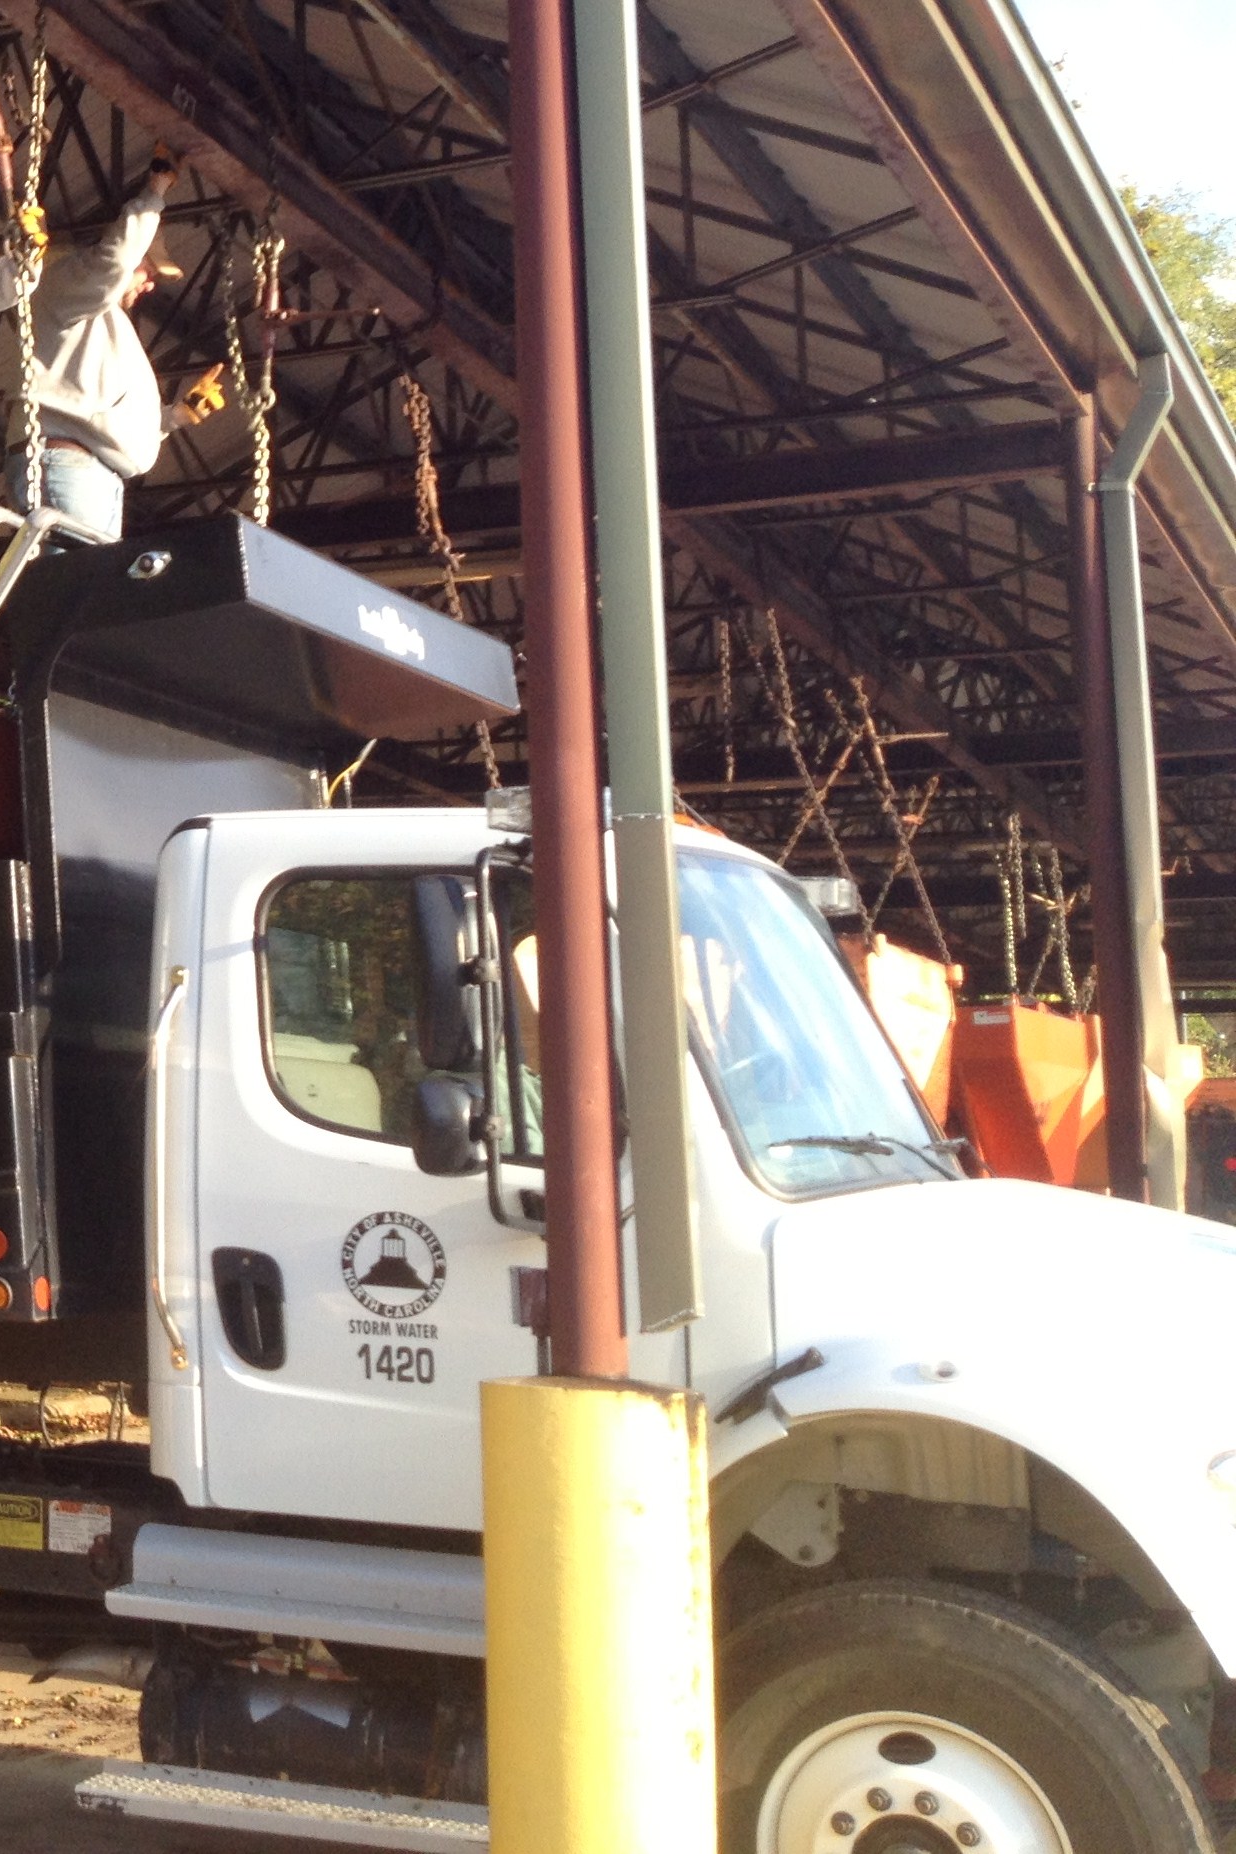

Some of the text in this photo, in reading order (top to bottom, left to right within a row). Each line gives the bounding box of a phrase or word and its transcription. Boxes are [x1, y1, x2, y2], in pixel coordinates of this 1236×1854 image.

[342, 1212, 445, 1266] CITY OF ASHEVILLE
[343, 1268, 445, 1317] NORTH CAROLINA
[349, 1319, 438, 1339] STORM WATER
[357, 1343, 435, 1384] 1420
